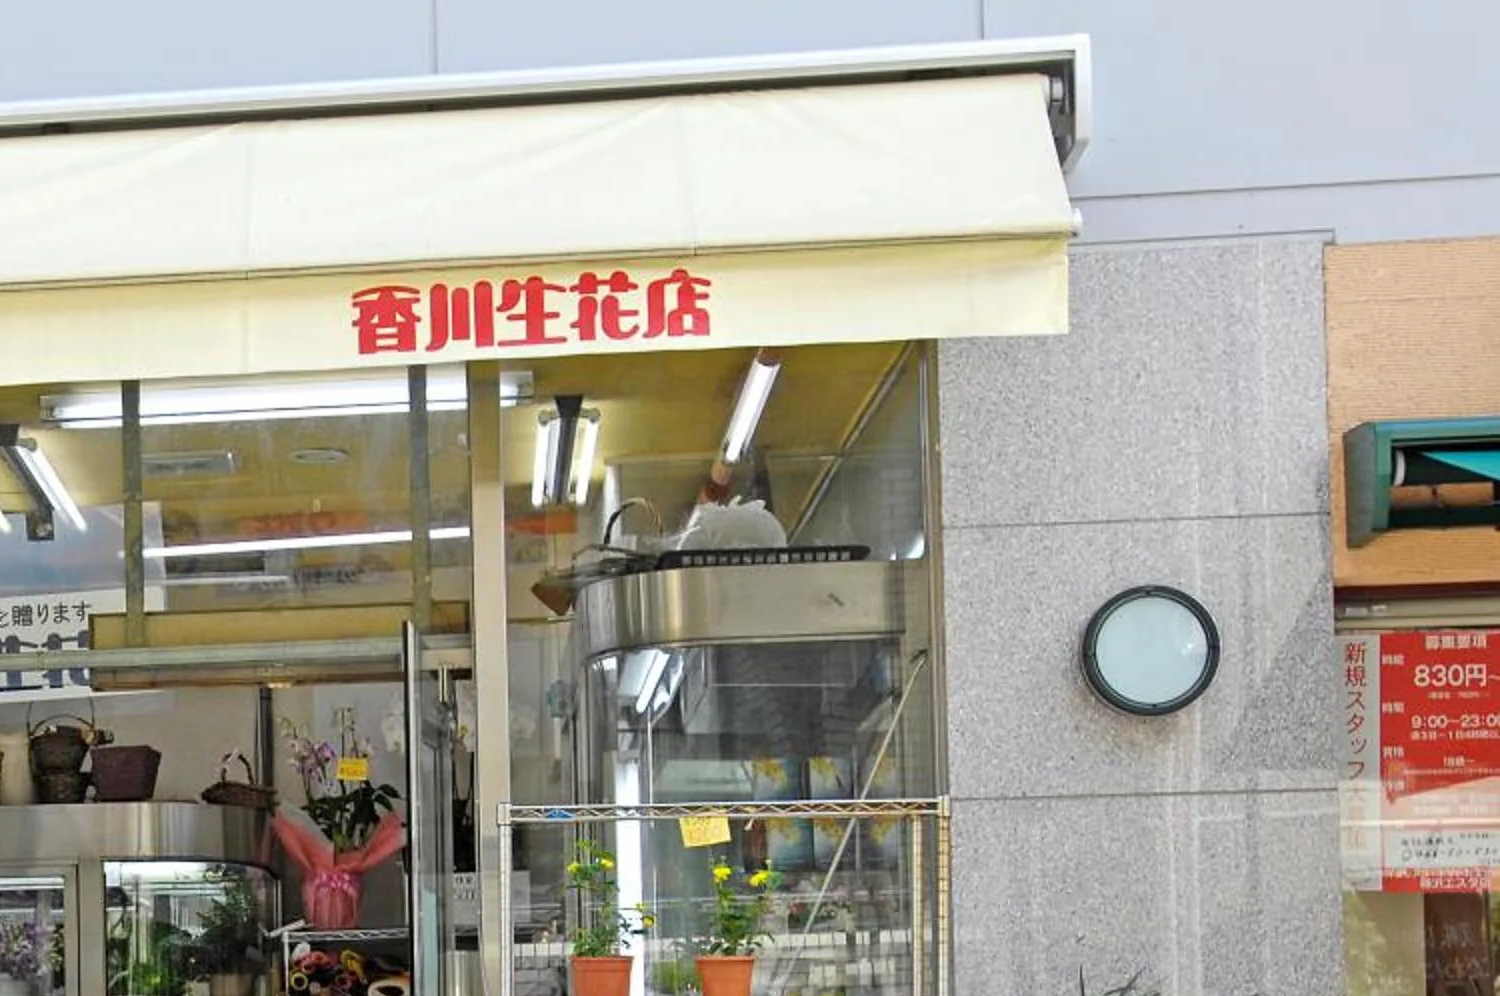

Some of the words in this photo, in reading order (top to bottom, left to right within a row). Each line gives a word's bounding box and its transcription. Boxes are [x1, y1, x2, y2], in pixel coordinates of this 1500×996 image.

[352, 267, 712, 355] 香川生花店
